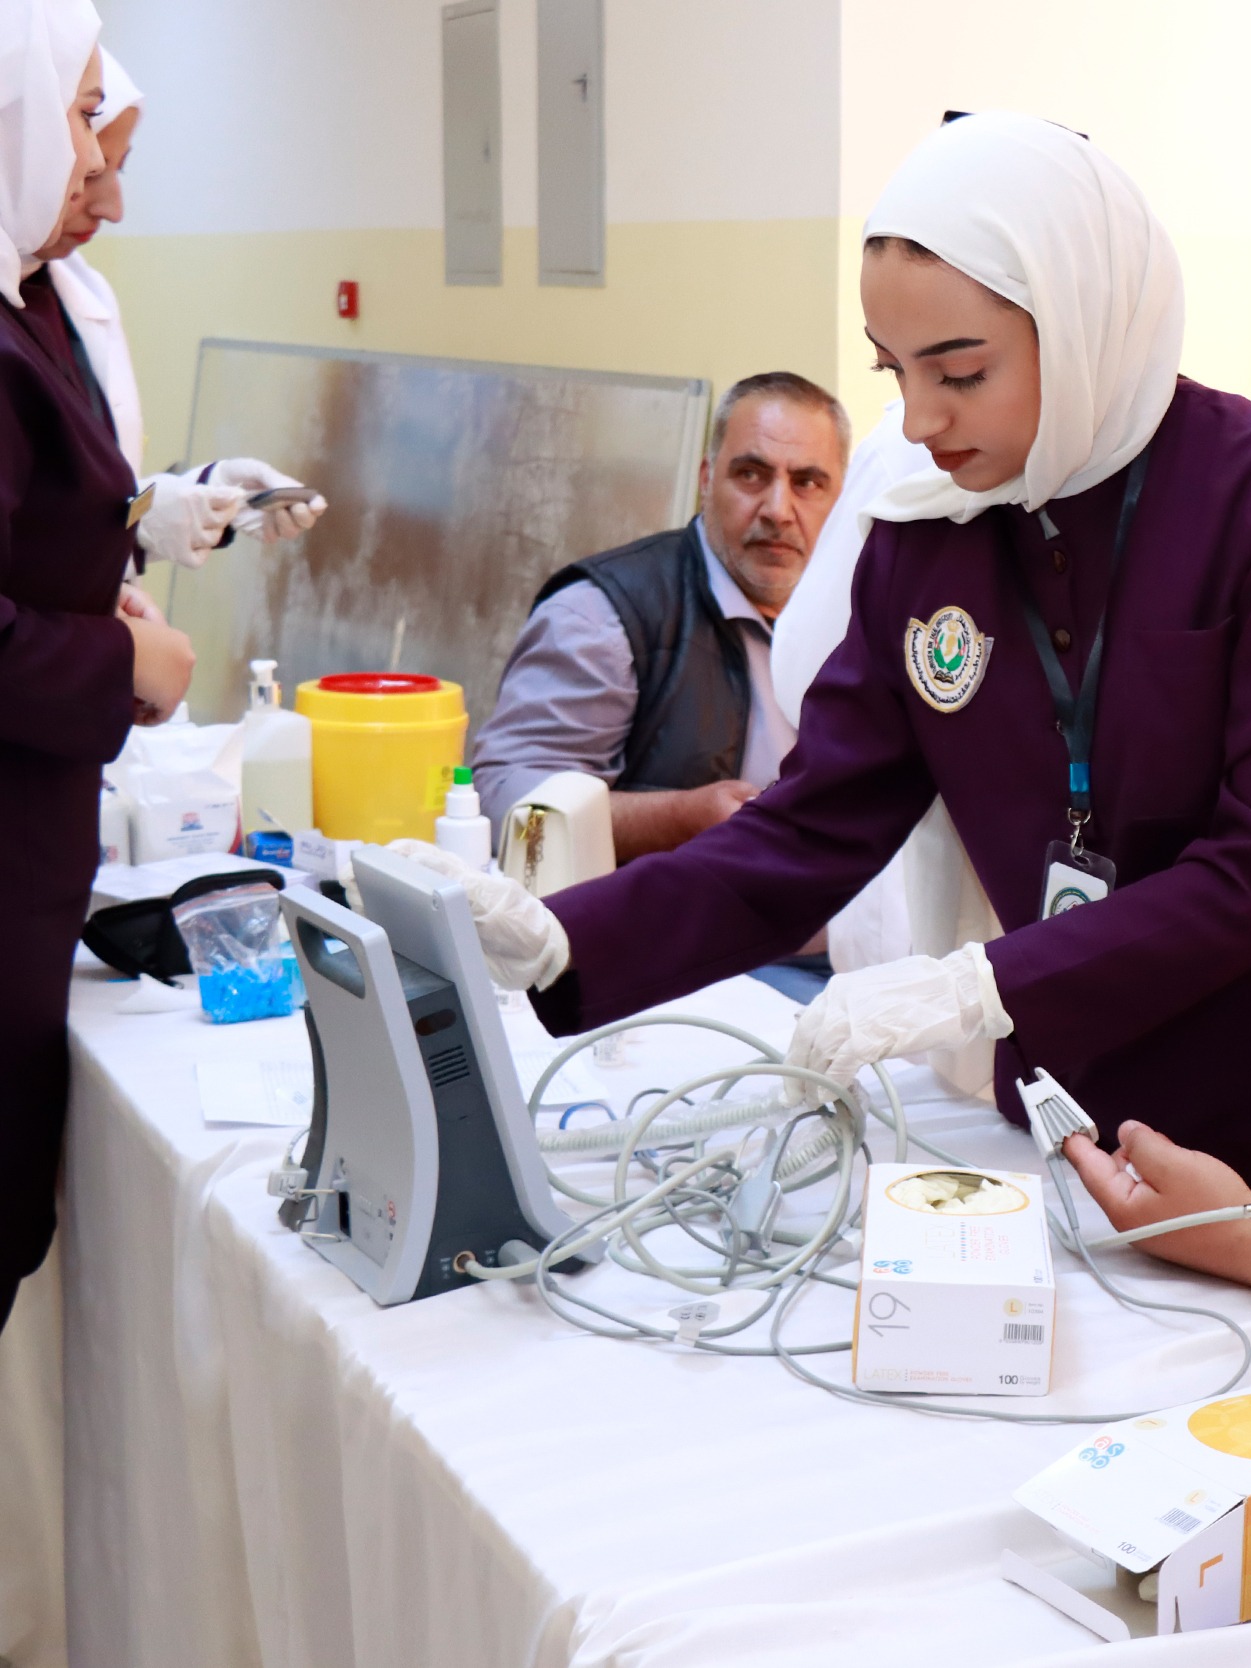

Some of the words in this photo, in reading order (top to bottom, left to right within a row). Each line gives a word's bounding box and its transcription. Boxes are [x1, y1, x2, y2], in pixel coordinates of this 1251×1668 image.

[863, 1368, 902, 1381] LATEX
[998, 1375, 1018, 1385] 100
[1117, 1541, 1137, 1555] 100
